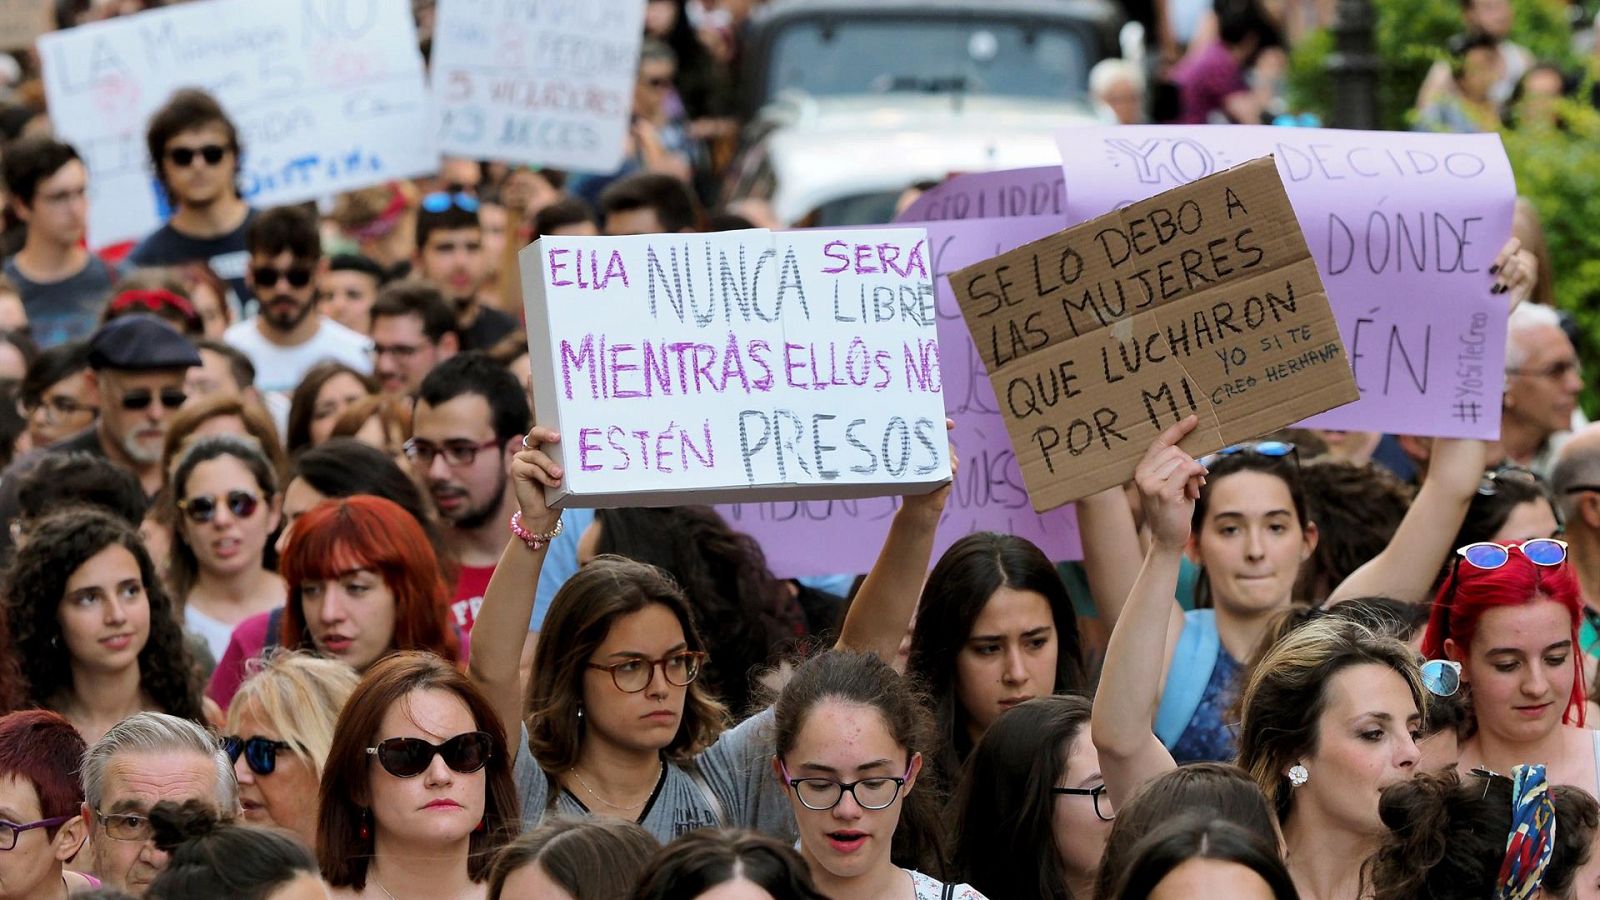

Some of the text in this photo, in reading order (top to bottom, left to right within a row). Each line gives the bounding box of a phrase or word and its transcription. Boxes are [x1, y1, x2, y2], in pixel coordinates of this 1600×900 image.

[1275, 141, 1485, 182] DECIDO
[967, 265, 1024, 318] SE
[1034, 246, 1084, 297] LO
[1093, 199, 1203, 269] DEBO
[1225, 186, 1248, 220] A
[1327, 195, 1483, 276] DÓNDE
[548, 247, 630, 290] ELLA
[647, 240, 810, 327] NUNCA
[820, 239, 928, 279] SERÁ
[833, 279, 936, 327] LIBRE
[991, 228, 1264, 369] LAS MUJERES
[784, 336, 893, 392] ELLOS
[903, 337, 942, 393] NO
[1006, 359, 1082, 420] QUE
[1100, 280, 1299, 384] LUCHARON
[1215, 323, 1313, 376] YO SI TE
[1031, 377, 1197, 475] POR MI
[1211, 375, 1258, 405] CREO
[579, 408, 941, 482] ESTÉN PRESOS
